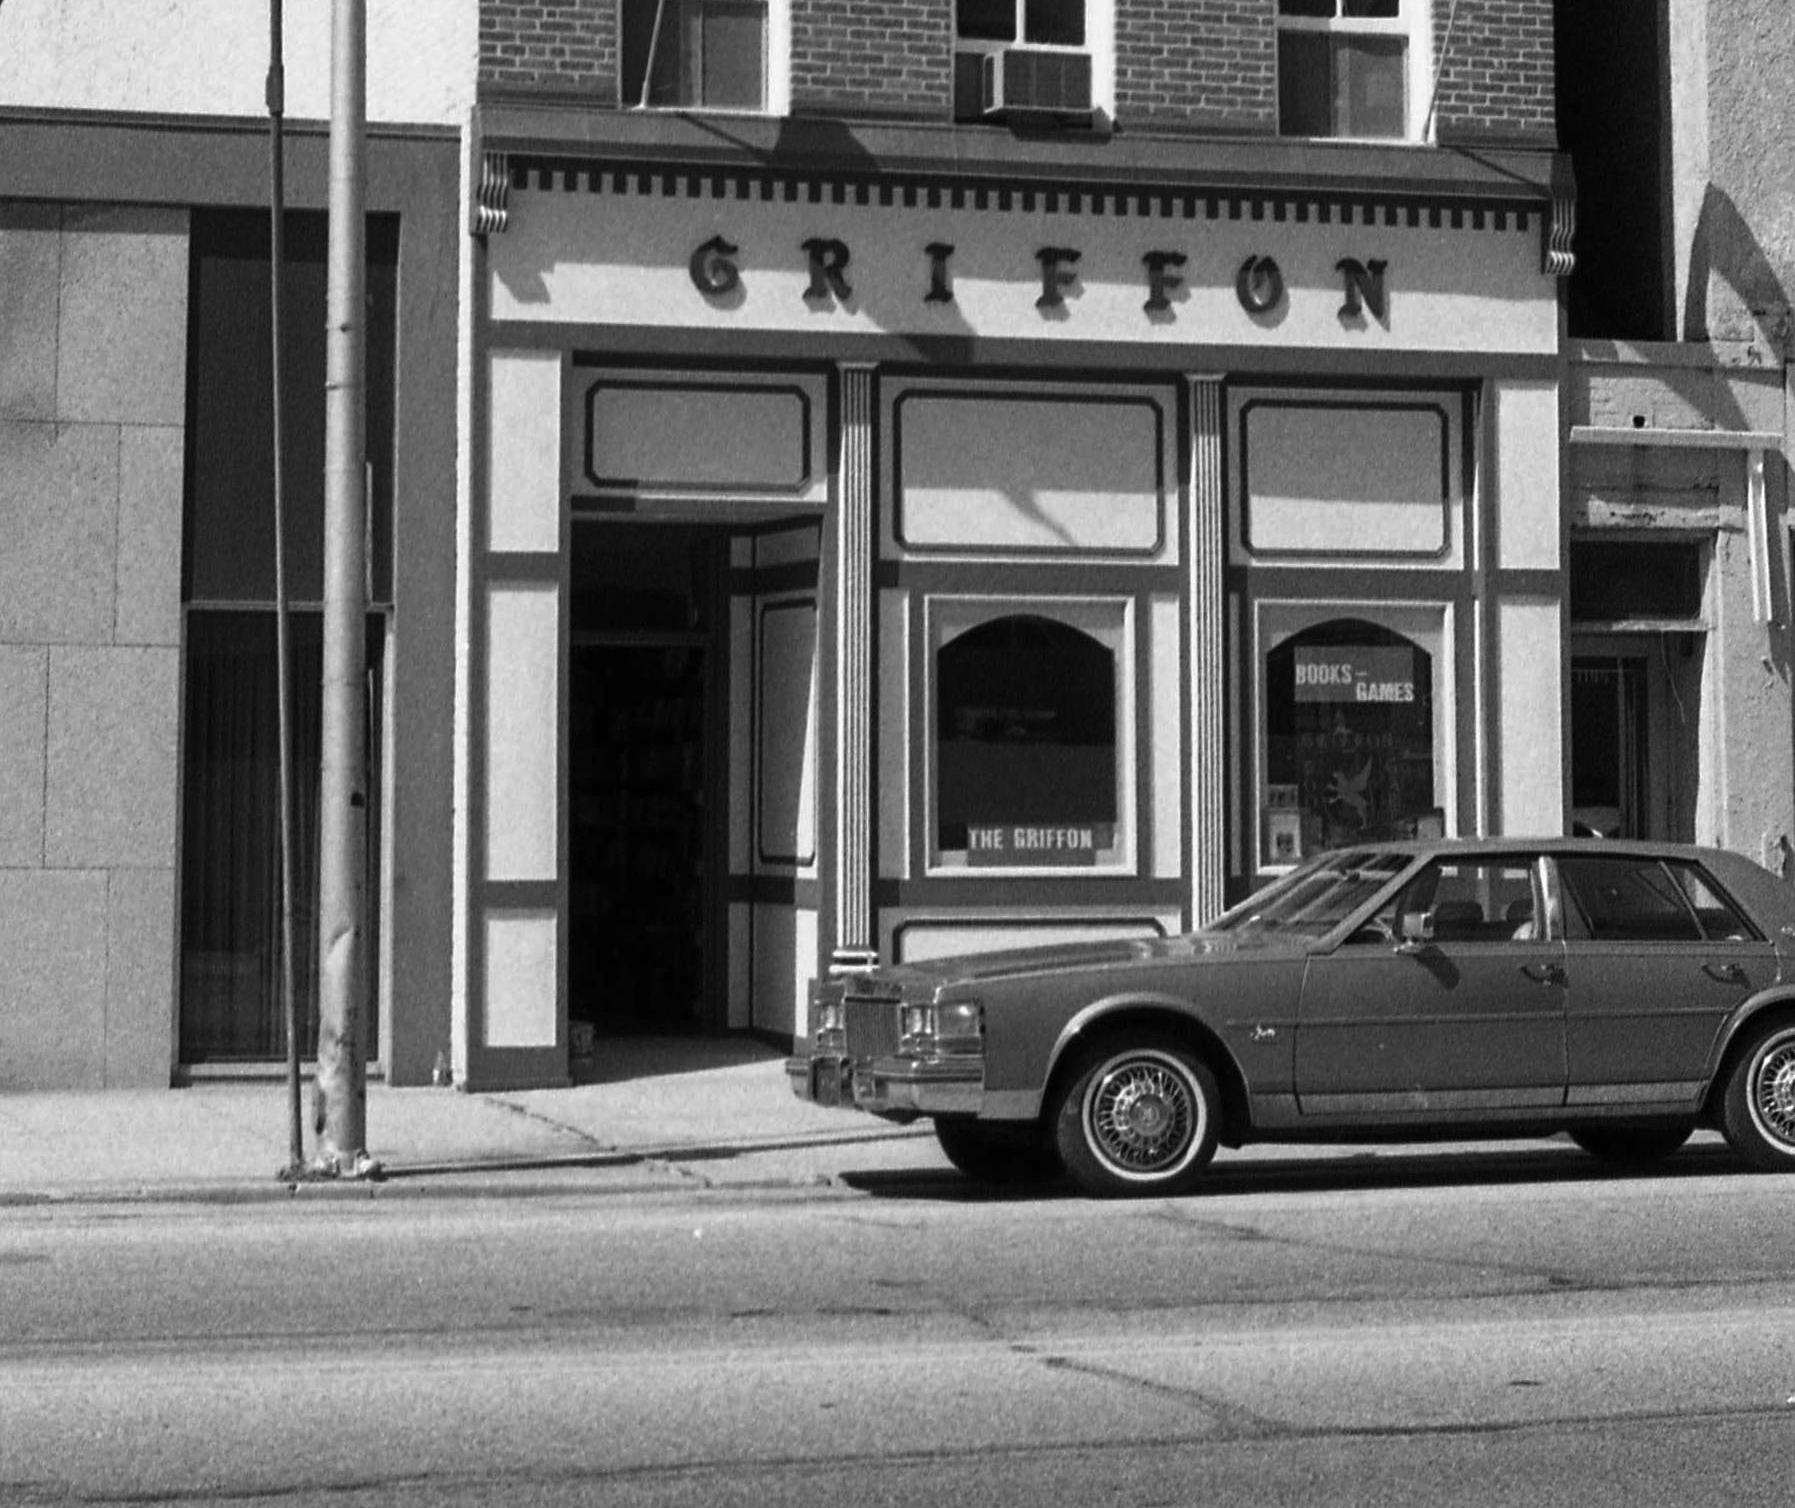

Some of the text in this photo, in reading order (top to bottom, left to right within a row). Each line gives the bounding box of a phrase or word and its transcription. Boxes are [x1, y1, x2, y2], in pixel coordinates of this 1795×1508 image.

[689, 234, 1388, 322] GRIFFON
[1355, 681, 1415, 703] GAMES
[968, 827, 1093, 850] THE GRIFFON
